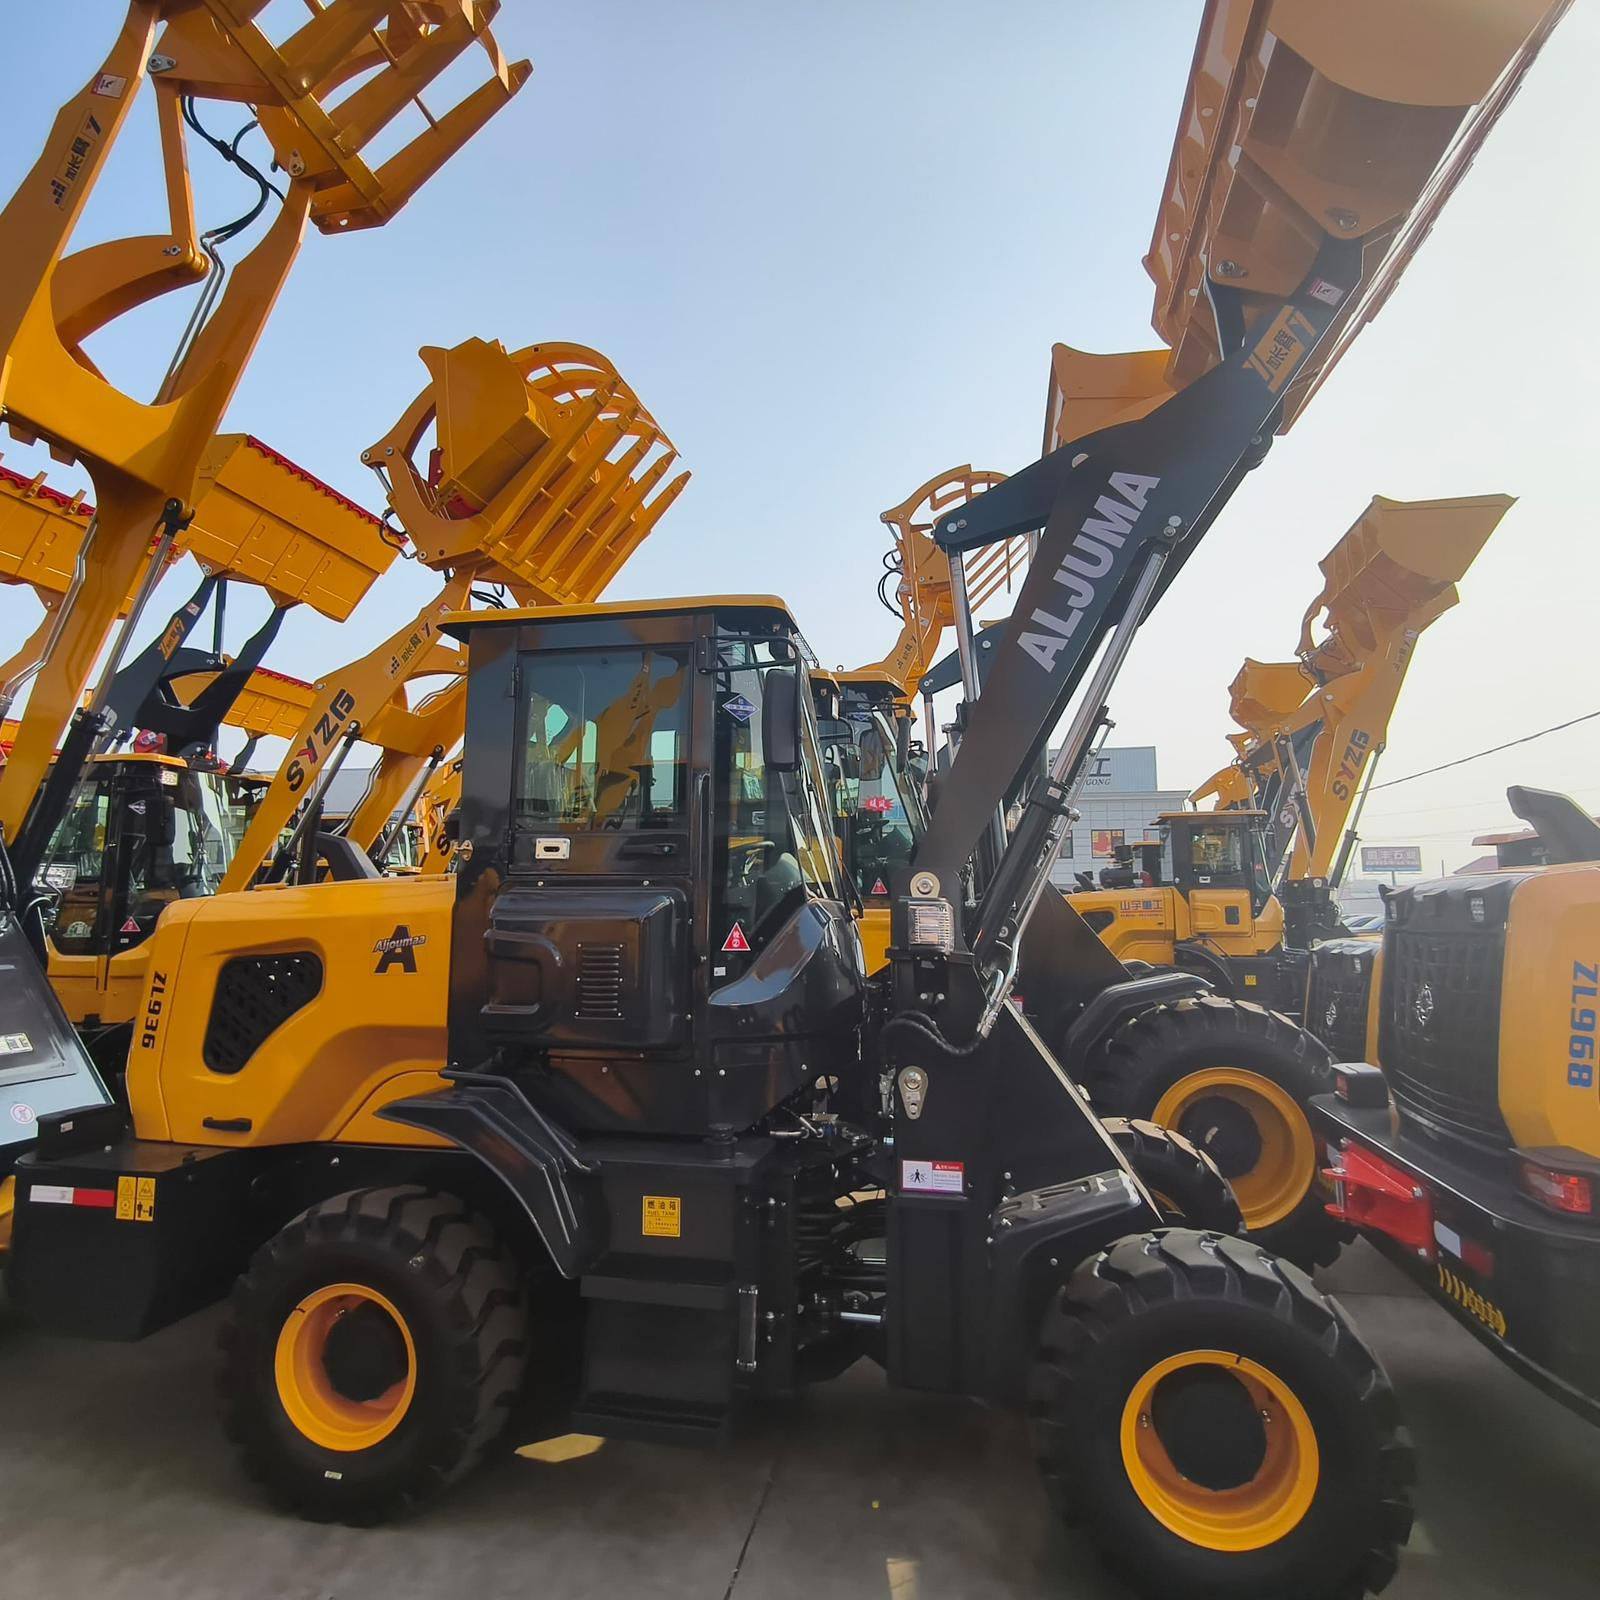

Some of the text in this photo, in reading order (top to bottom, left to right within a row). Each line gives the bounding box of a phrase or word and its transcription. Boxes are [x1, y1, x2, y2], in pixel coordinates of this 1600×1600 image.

[1016, 471, 1160, 673] ALJUMA
[286, 688, 355, 792] SYZG
[1332, 729, 1370, 801] SYZG
[142, 970, 168, 1049] ZL936
[1568, 960, 1599, 1088] ZL968
